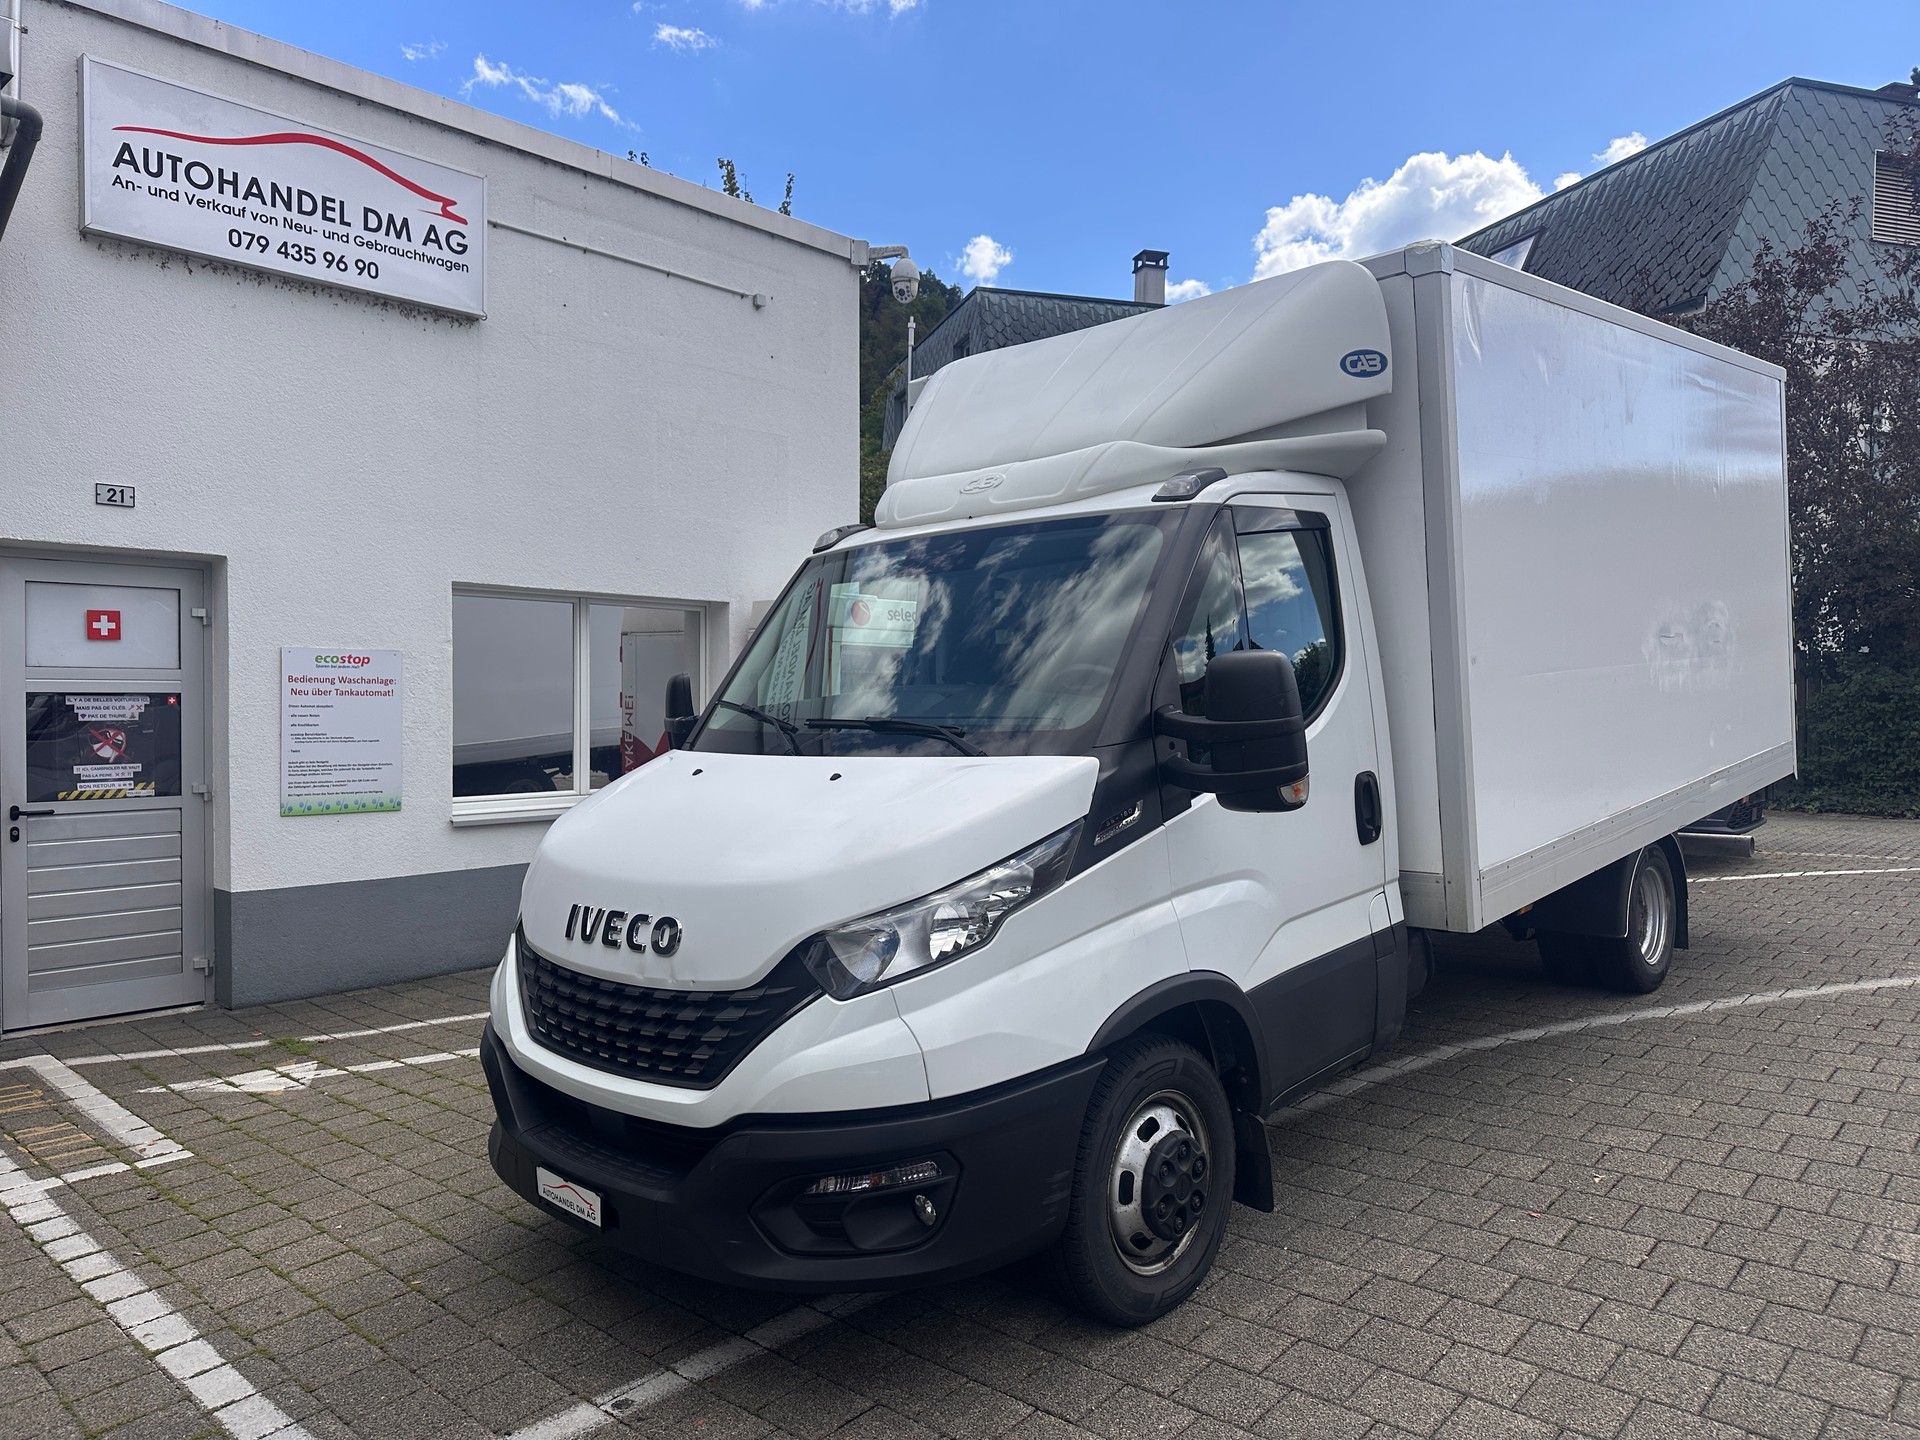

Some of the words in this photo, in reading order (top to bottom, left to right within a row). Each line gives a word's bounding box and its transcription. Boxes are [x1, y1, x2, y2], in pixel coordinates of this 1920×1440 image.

[112, 142, 351, 228] AUTOHANDEL
[363, 206, 412, 243] DM
[421, 224, 469, 255] AG
[112, 174, 143, 192] An-
[148, 186, 179, 202] und
[185, 191, 247, 219] Verkauf
[250, 211, 278, 227] von
[283, 217, 318, 235] Neu-
[323, 229, 349, 244] und
[354, 235, 470, 273] Gebrauchtwagen
[228, 228, 270, 254] 079
[277, 241, 317, 265] 435
[323, 251, 349, 273] 96
[354, 258, 380, 280] 90
[1346, 353, 1382, 373] CAB
[107, 488, 125, 504] 21
[314, 654, 371, 667] ecostop
[288, 675, 336, 686] Bedienung
[338, 676, 397, 687] Waschanlage:
[290, 688, 309, 696] Neu
[311, 688, 332, 697] über
[334, 688, 395, 697] Tankautomat!
[565, 904, 683, 958] IVECO
[542, 1187, 576, 1211] AUTOHANDEL
[576, 1204, 586, 1217] DM
[586, 1210, 597, 1221] AG
